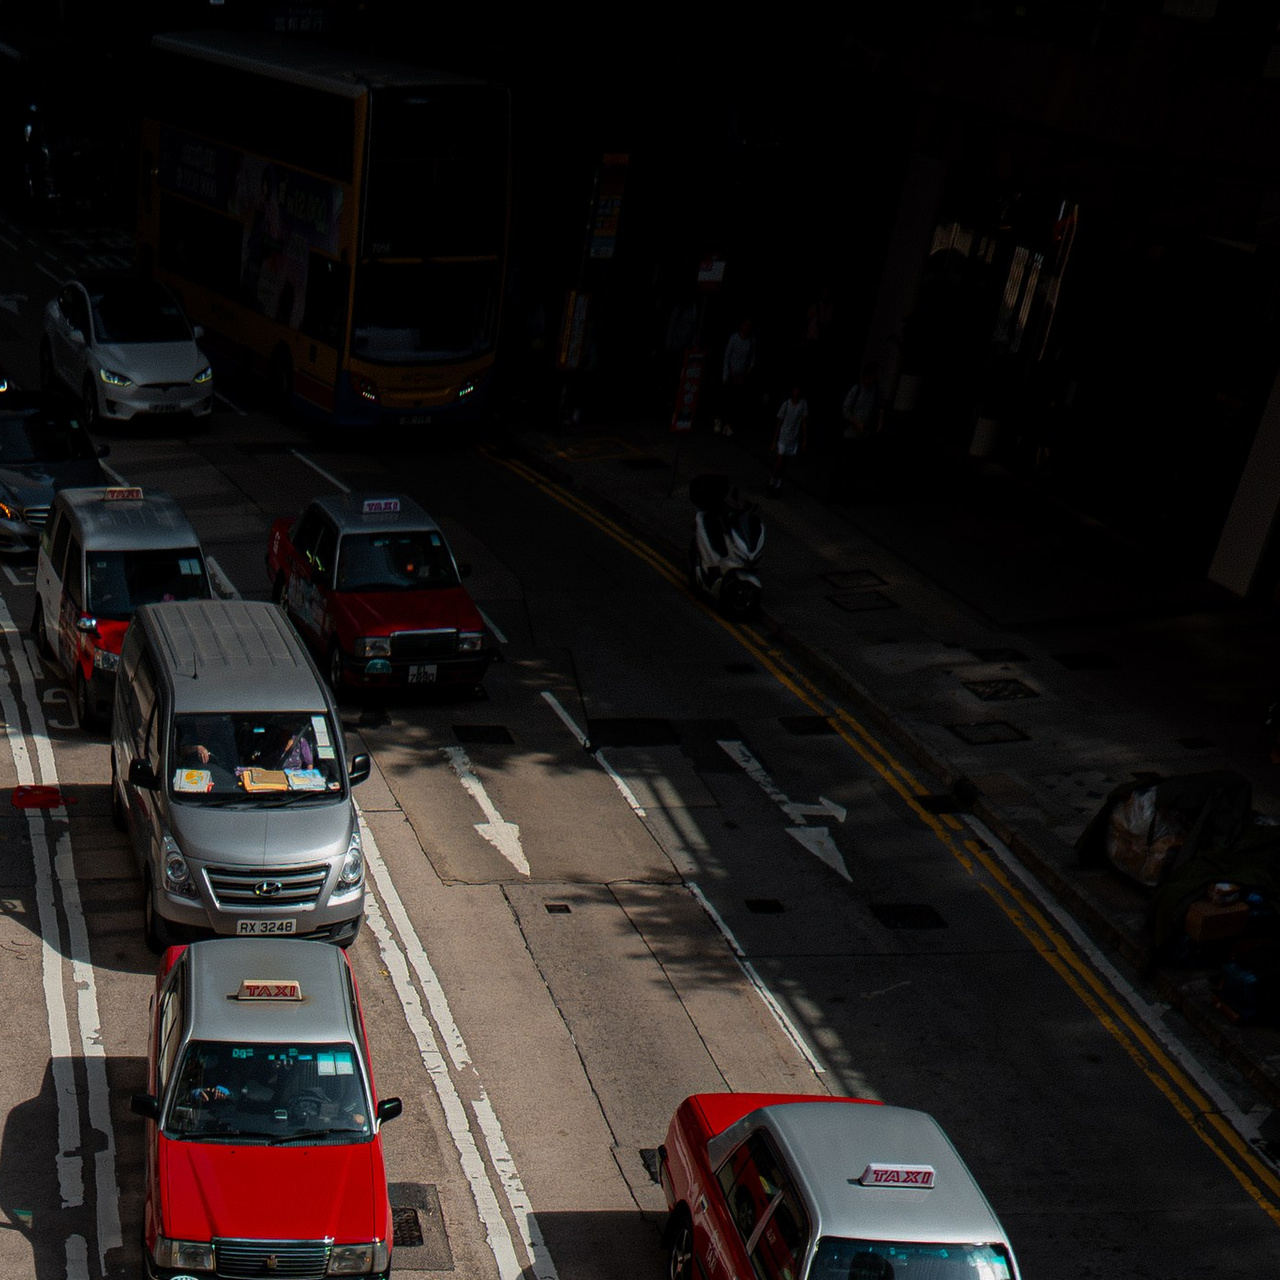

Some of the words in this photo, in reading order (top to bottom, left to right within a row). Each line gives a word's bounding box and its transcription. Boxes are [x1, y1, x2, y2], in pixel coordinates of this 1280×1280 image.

[108, 489, 140, 498] TAXI
[367, 501, 398, 511] TAXI
[240, 922, 256, 933] RX
[260, 921, 293, 933] 3248
[245, 985, 296, 997] TAXI
[873, 1169, 932, 1184] TAXI
